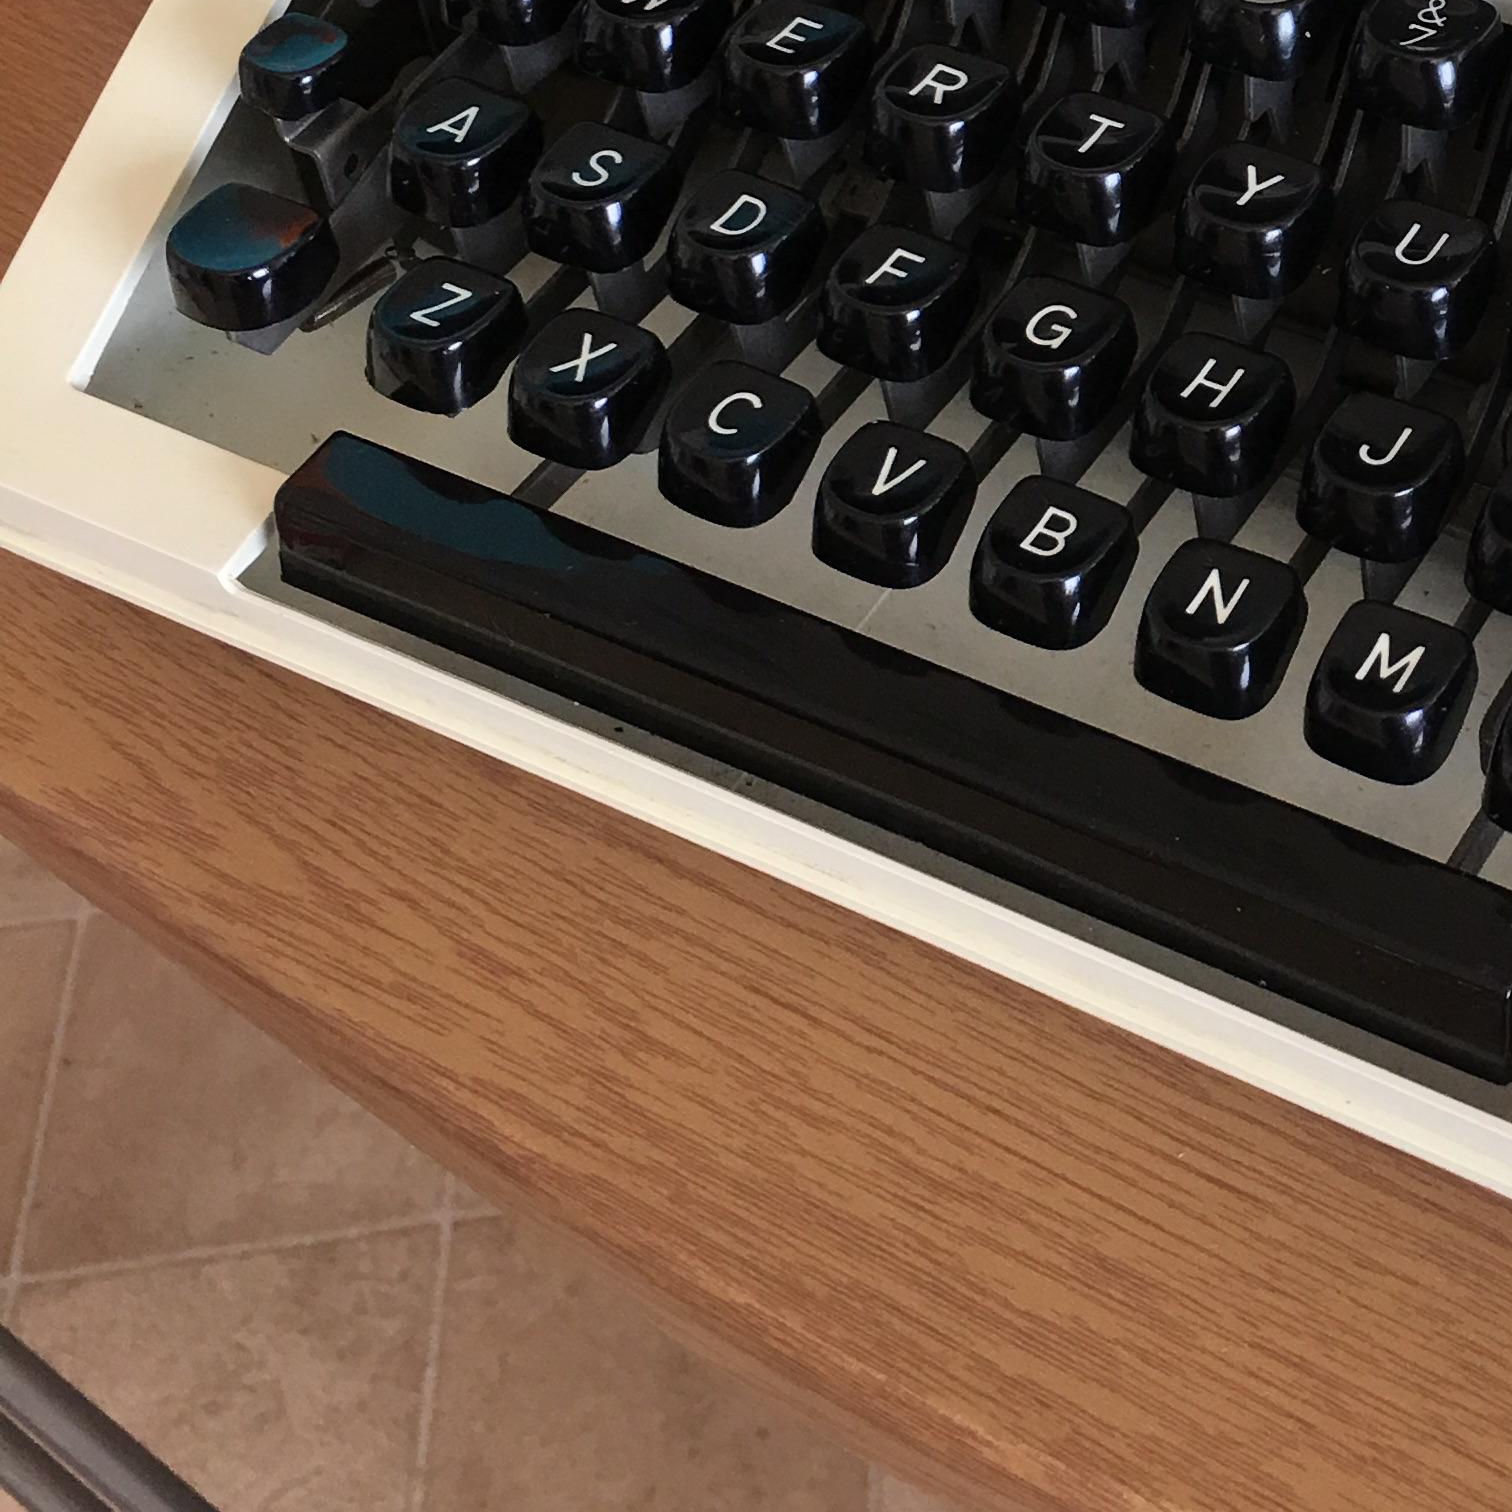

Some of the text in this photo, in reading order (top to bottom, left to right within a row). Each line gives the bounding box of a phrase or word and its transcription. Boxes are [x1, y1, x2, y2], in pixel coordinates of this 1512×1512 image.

[765, 16, 824, 54] E
[1399, 23, 1437, 47] 7
[908, 63, 969, 105] R
[426, 105, 480, 143] A
[1076, 113, 1125, 153] T
[571, 149, 623, 187] S
[1235, 164, 1285, 206] Y
[709, 194, 767, 235] D
[1394, 223, 1450, 265] U
[864, 248, 926, 285] F
[409, 282, 473, 327] Z
[1024, 304, 1078, 349] G
[549, 332, 618, 383] X
[1179, 358, 1245, 408] H
[707, 391, 764, 436] C
[1358, 428, 1413, 466] J
[871, 446, 927, 496] V
[1019, 505, 1078, 557] B
[1185, 568, 1250, 625] N
[1355, 632, 1426, 693] M
